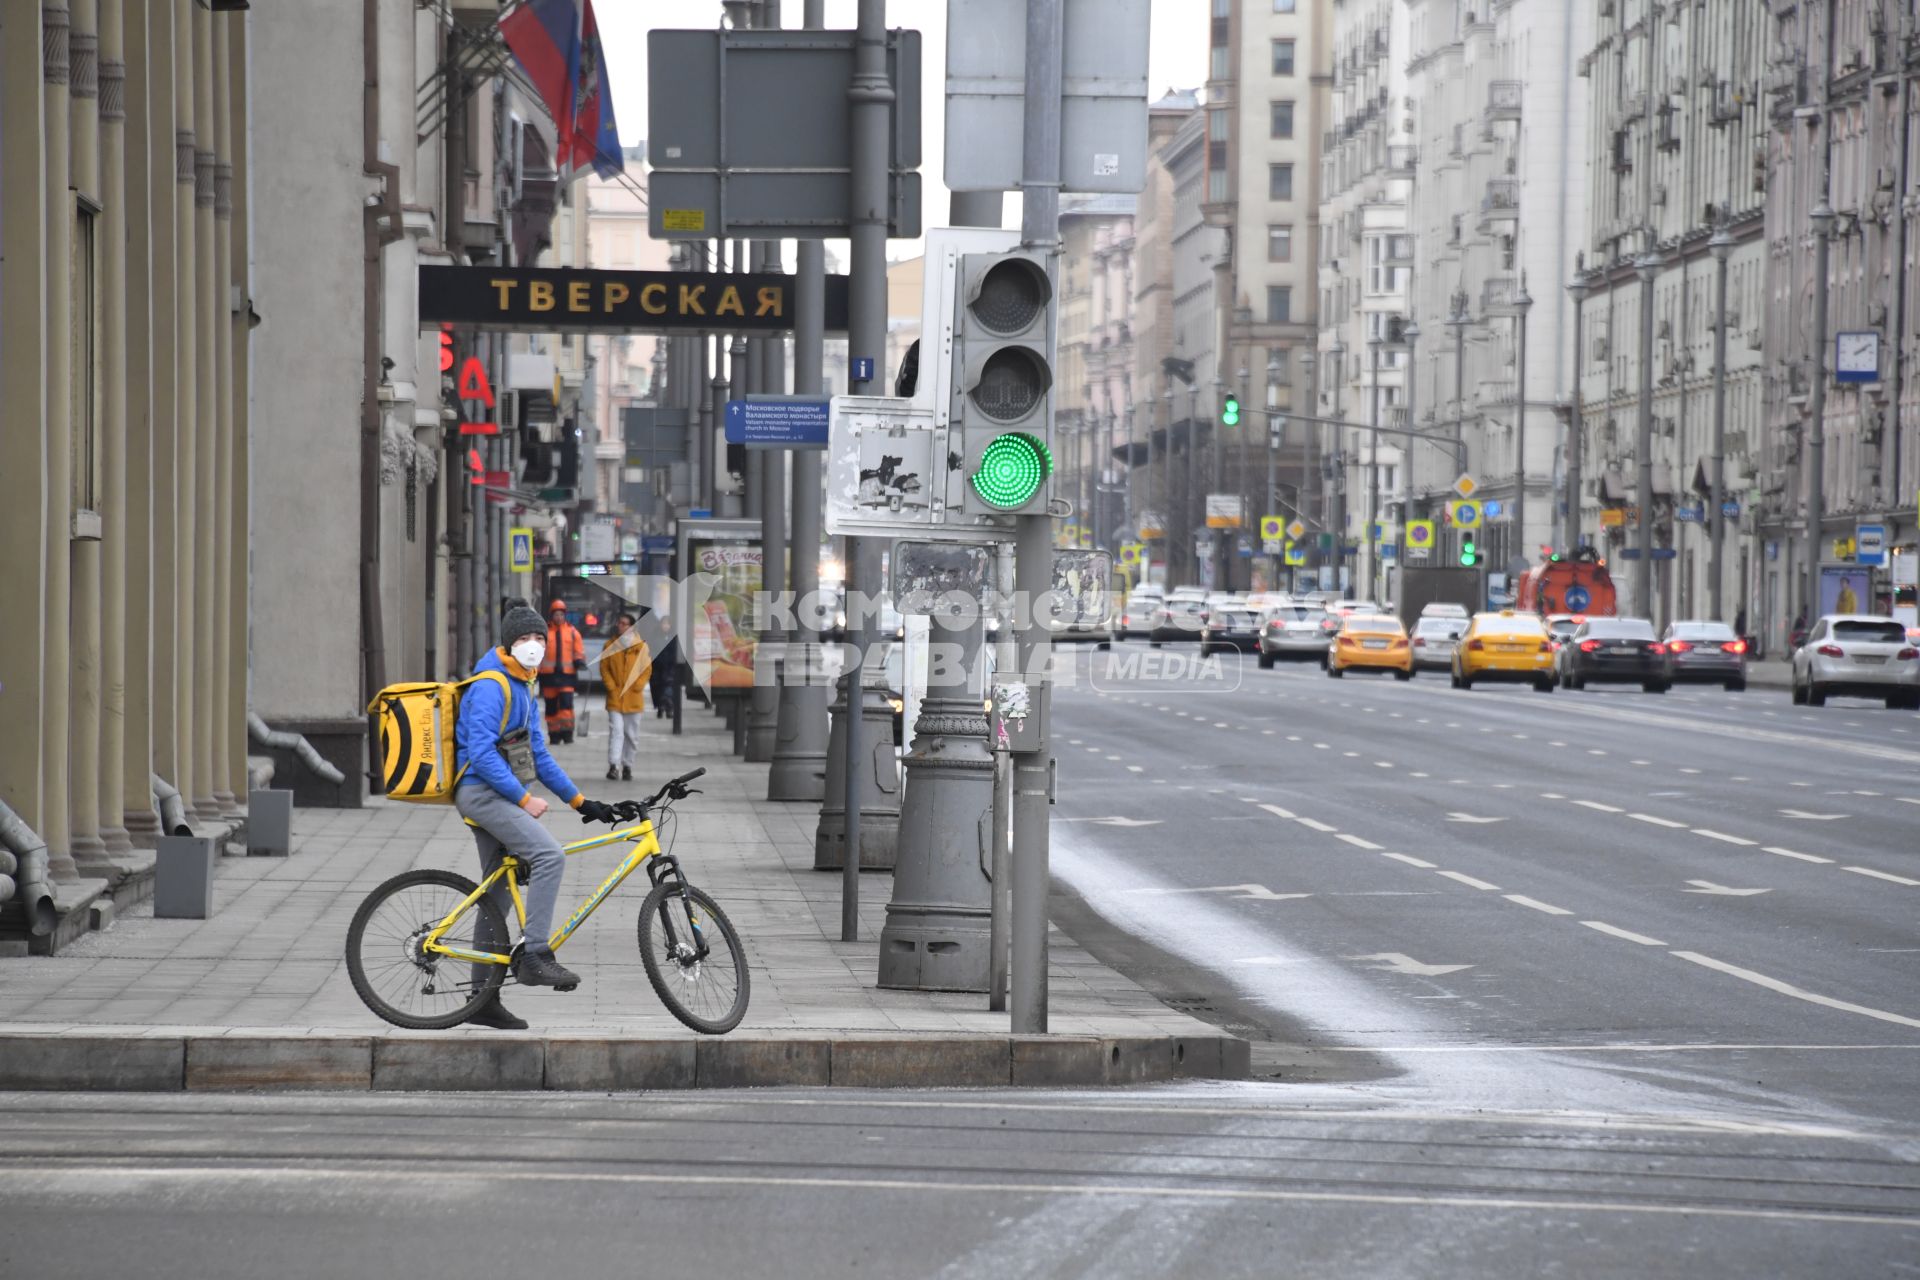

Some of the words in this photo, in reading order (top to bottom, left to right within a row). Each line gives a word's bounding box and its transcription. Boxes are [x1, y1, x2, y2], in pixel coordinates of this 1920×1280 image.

[491, 279, 784, 318] ТВЕРСКАЯ
[745, 404, 786, 412] Московское
[787, 406, 820, 415] подворье
[745, 412, 788, 420] Валаамского
[789, 414, 827, 422] монастыря
[420, 708, 432, 725] Еда
[421, 726, 432, 759] Яндекс
